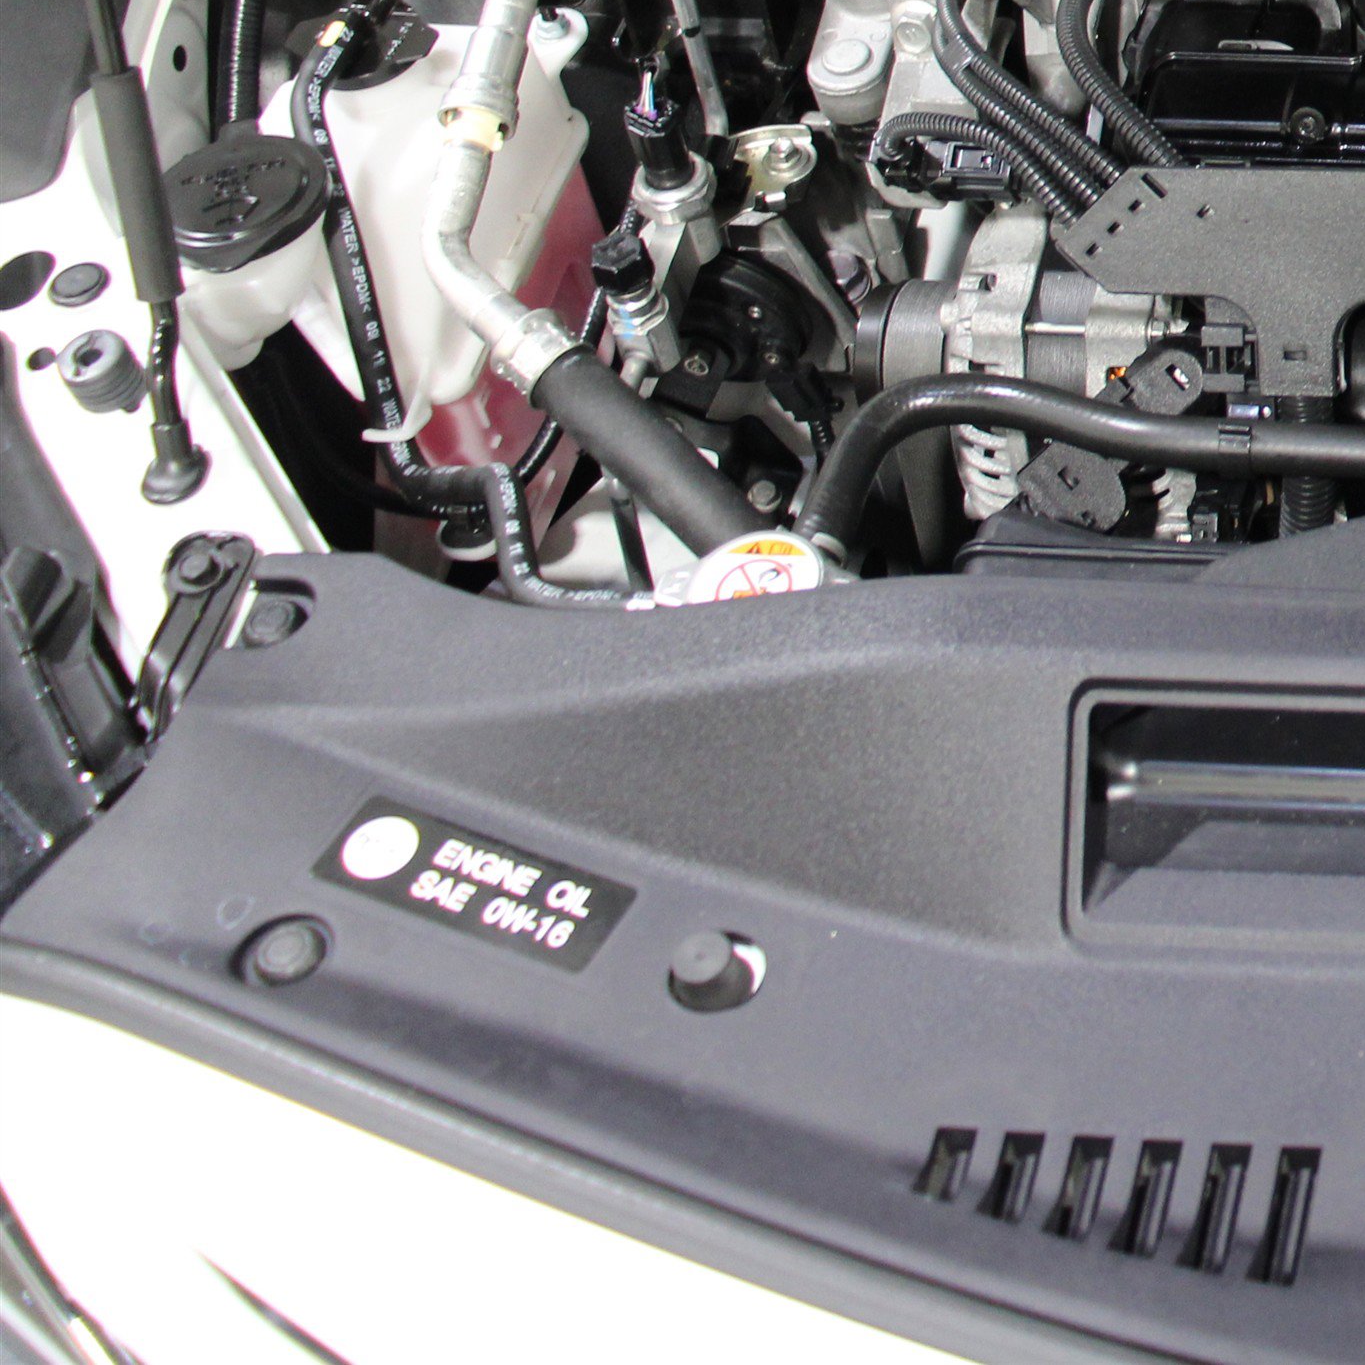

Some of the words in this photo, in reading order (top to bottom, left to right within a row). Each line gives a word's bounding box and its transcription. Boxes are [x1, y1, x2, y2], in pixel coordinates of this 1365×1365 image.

[338, 207, 360, 254] WATER
[408, 869, 477, 914] SAE
[480, 895, 576, 950] 0W-16
[431, 837, 543, 898] ENGINE
[545, 879, 593, 919] OIL
